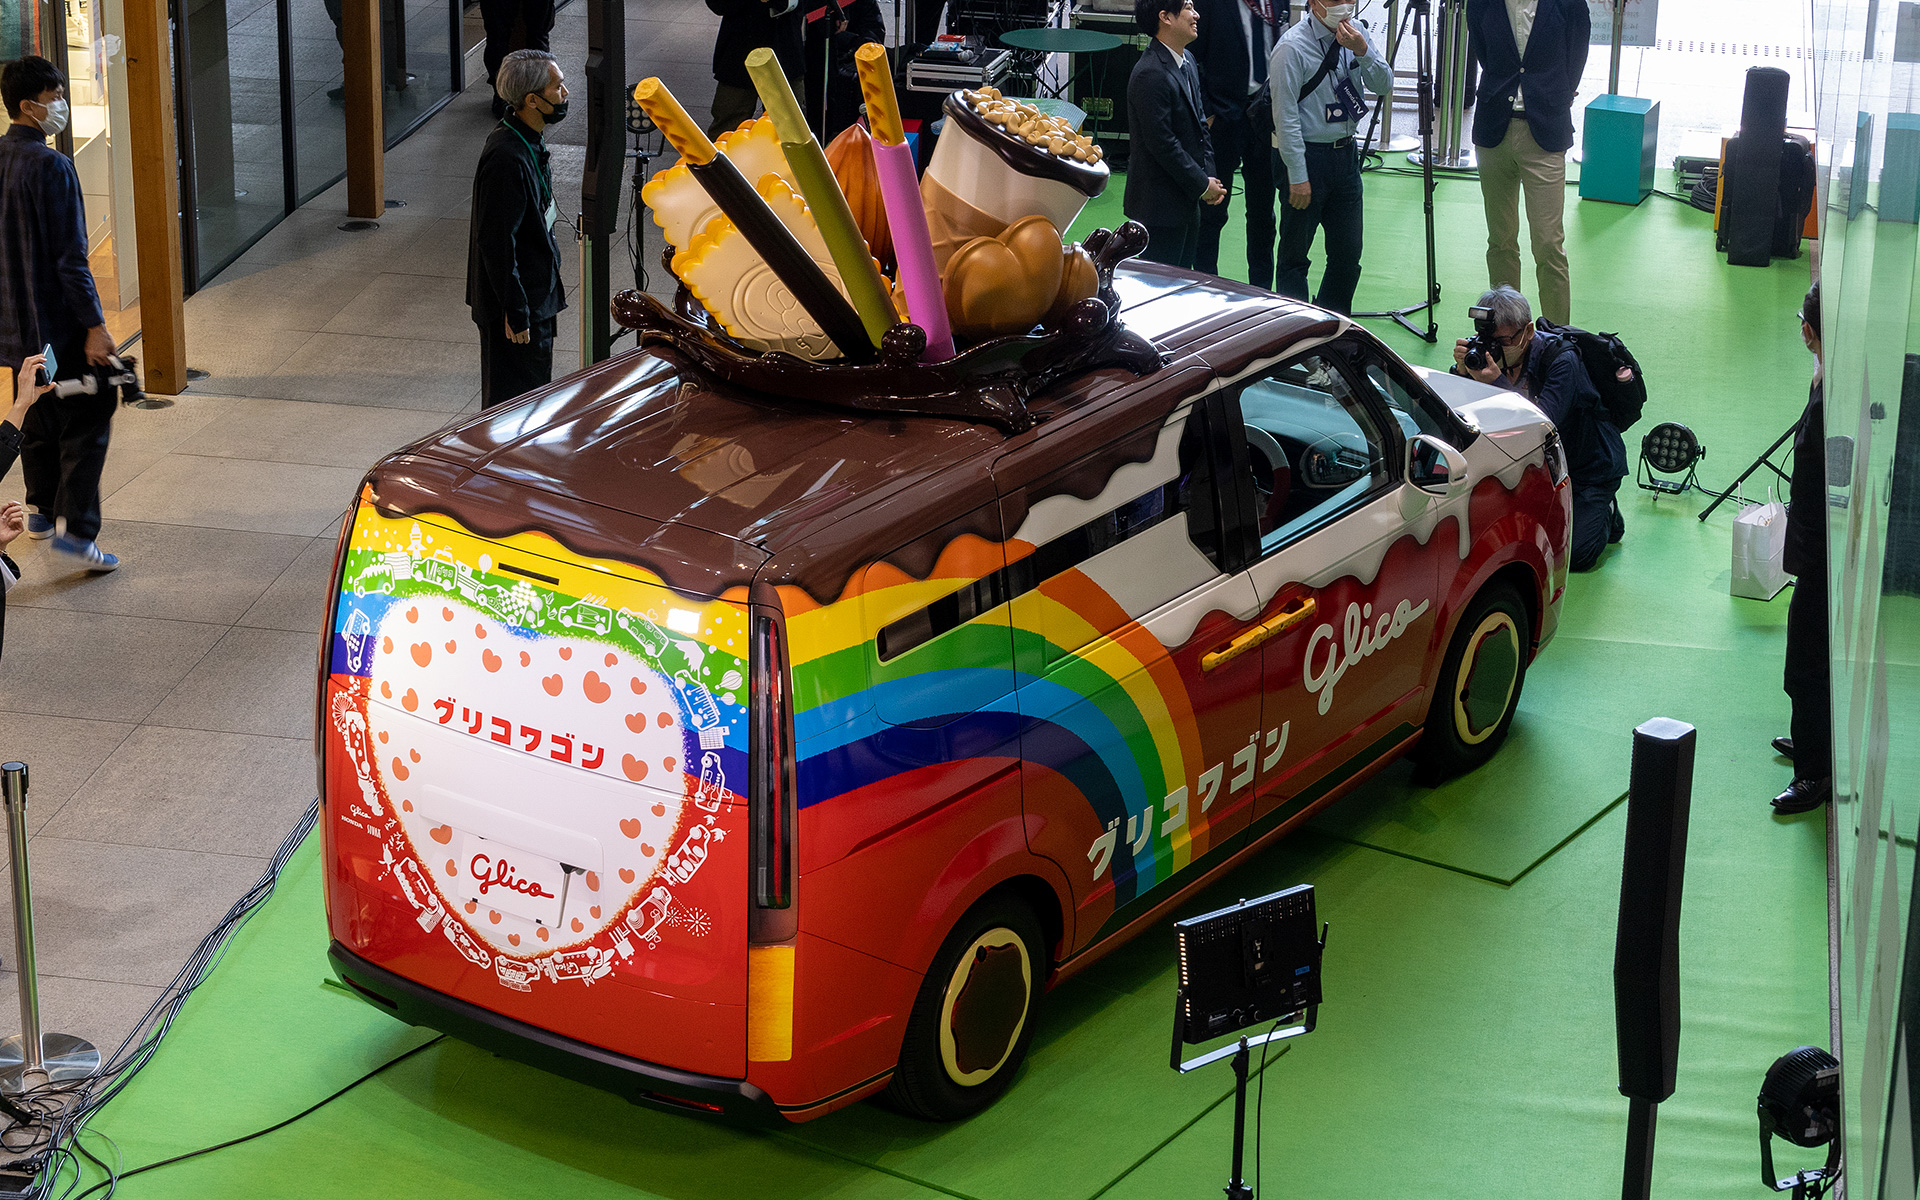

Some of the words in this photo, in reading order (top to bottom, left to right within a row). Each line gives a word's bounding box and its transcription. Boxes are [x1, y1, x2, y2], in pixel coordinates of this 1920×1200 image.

[1343, 86, 1356, 103] Honda
[1353, 102, 1364, 115] TV
[1303, 598, 1430, 716] Glico
[433, 696, 605, 770] グリコワゴン
[341, 815, 363, 829] HONDA
[350, 804, 371, 819] Glico
[1087, 720, 1290, 881] グリコワゴン
[471, 853, 554, 898] Glico
